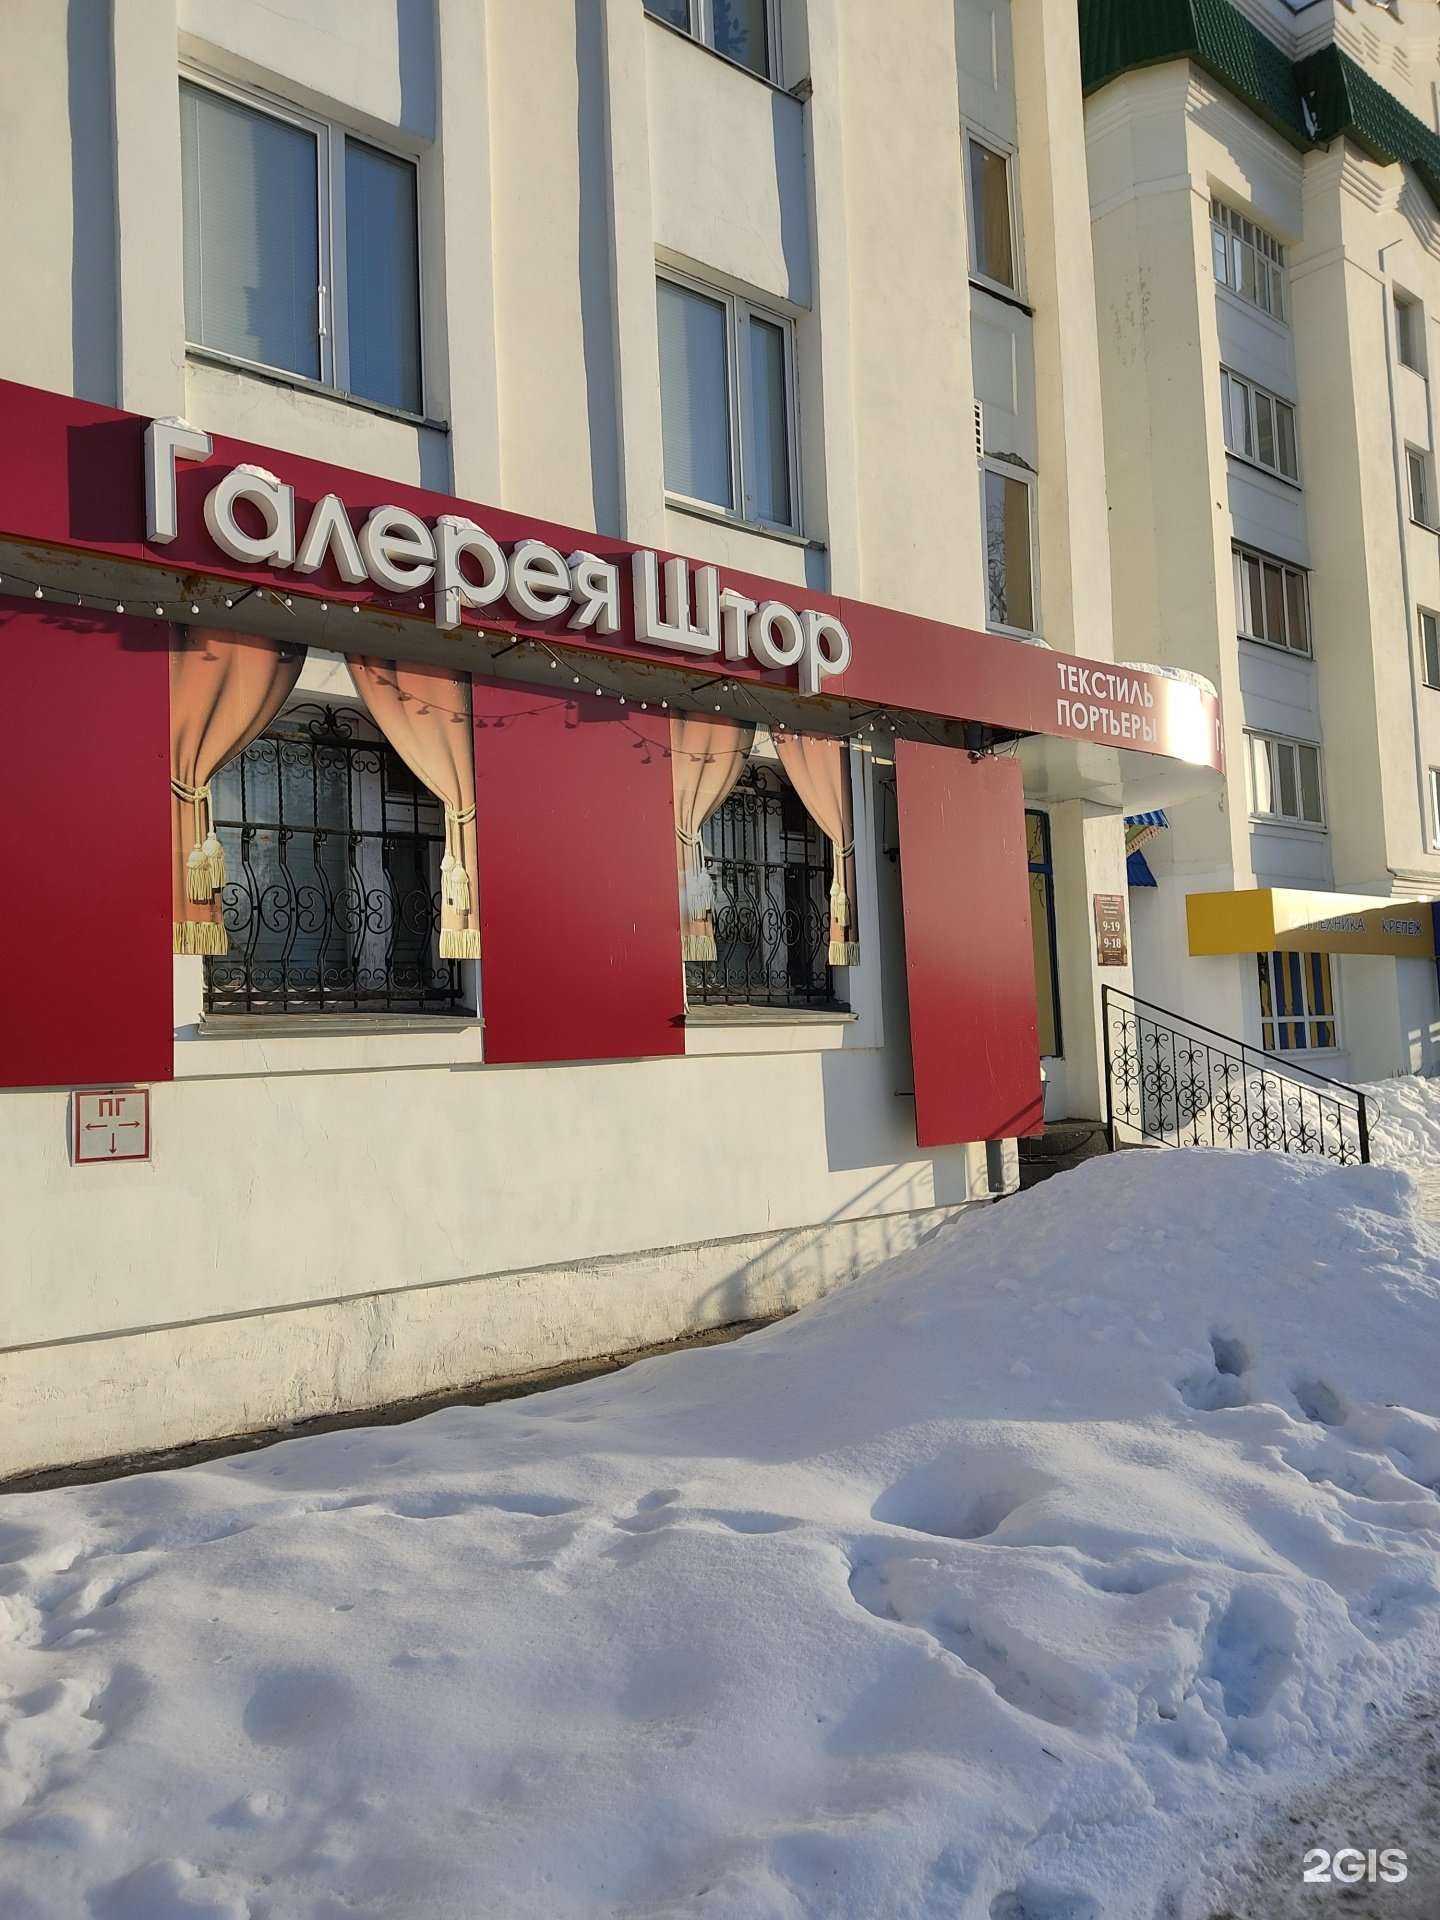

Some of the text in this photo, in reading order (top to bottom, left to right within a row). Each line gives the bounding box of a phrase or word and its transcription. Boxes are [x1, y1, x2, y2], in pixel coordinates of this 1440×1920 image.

[145, 418, 852, 697] Галерея Штор
[1057, 663, 1154, 708] ТЕКСТИЛЬ
[1057, 698, 1158, 742] ПОРТЬЕРЫ
[99, 1097, 126, 1117] ПГ
